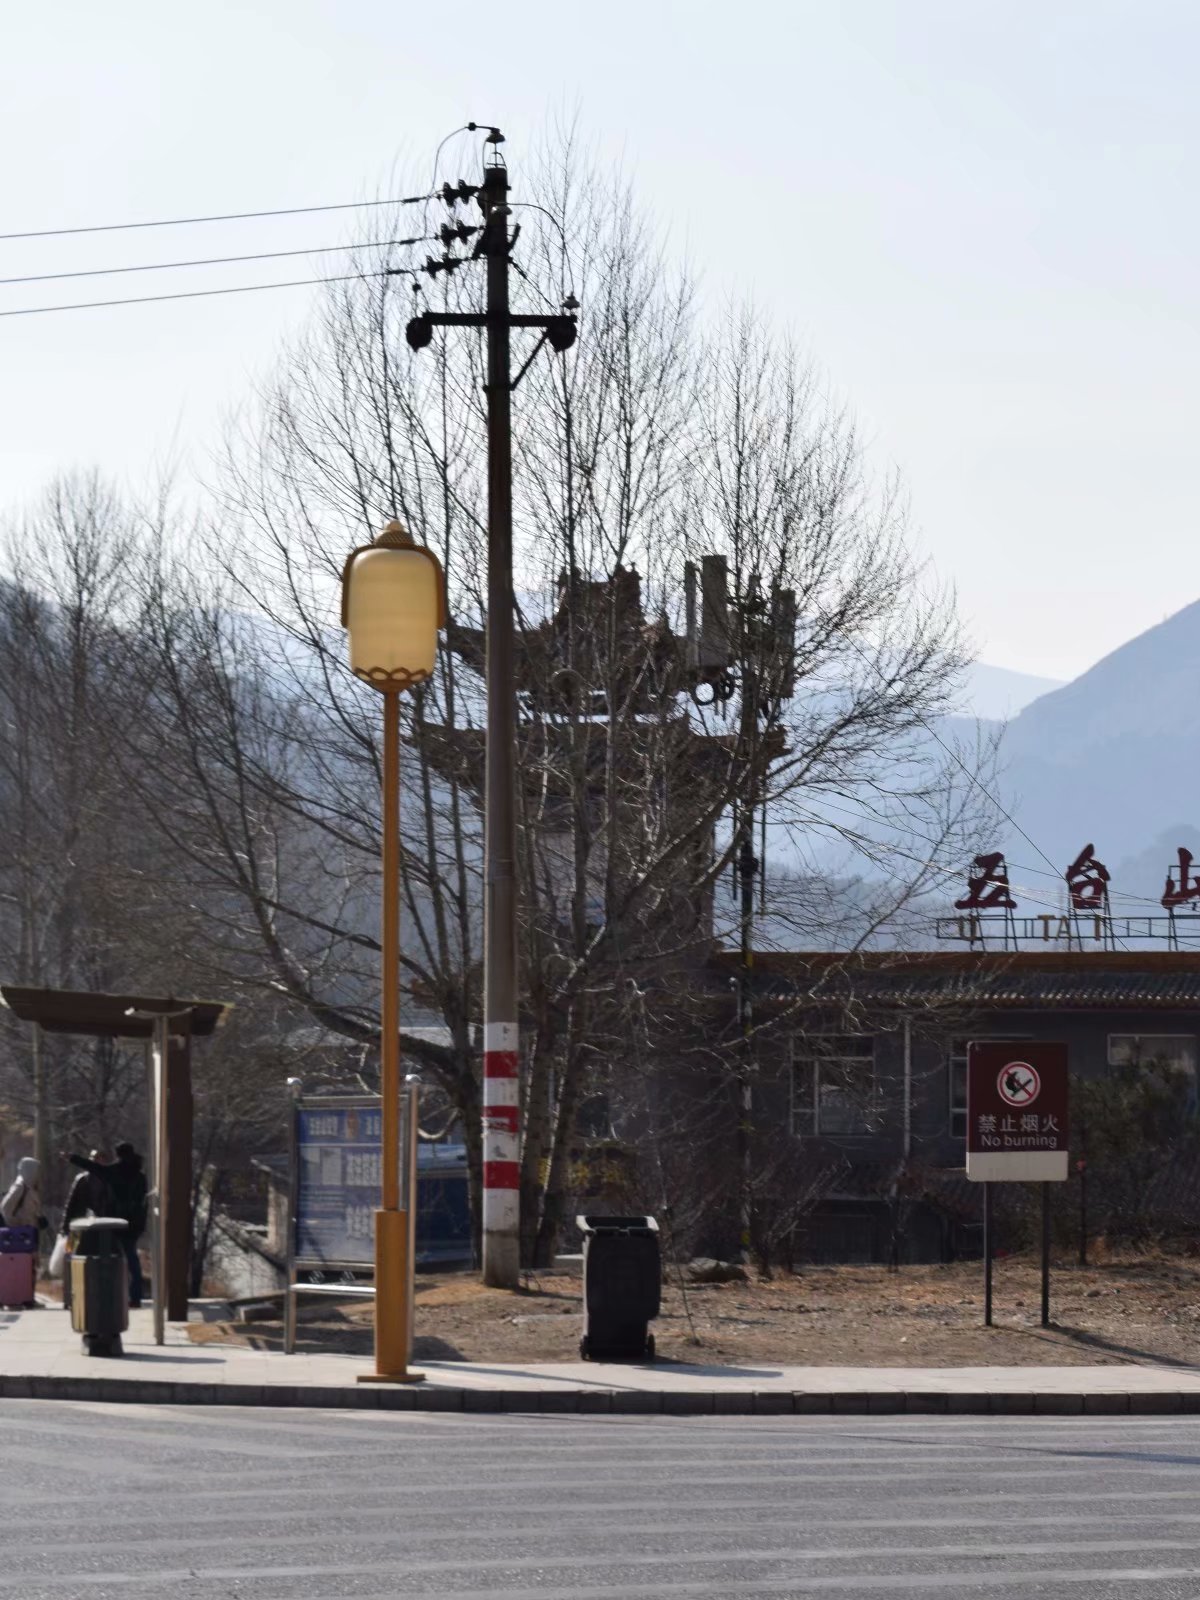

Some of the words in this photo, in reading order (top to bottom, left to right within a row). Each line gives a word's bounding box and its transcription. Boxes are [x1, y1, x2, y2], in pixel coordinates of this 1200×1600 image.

[978, 1113, 1060, 1133] 禁止烟火
[981, 1134, 1001, 1147] No
[1003, 1133, 1058, 1149] burning
